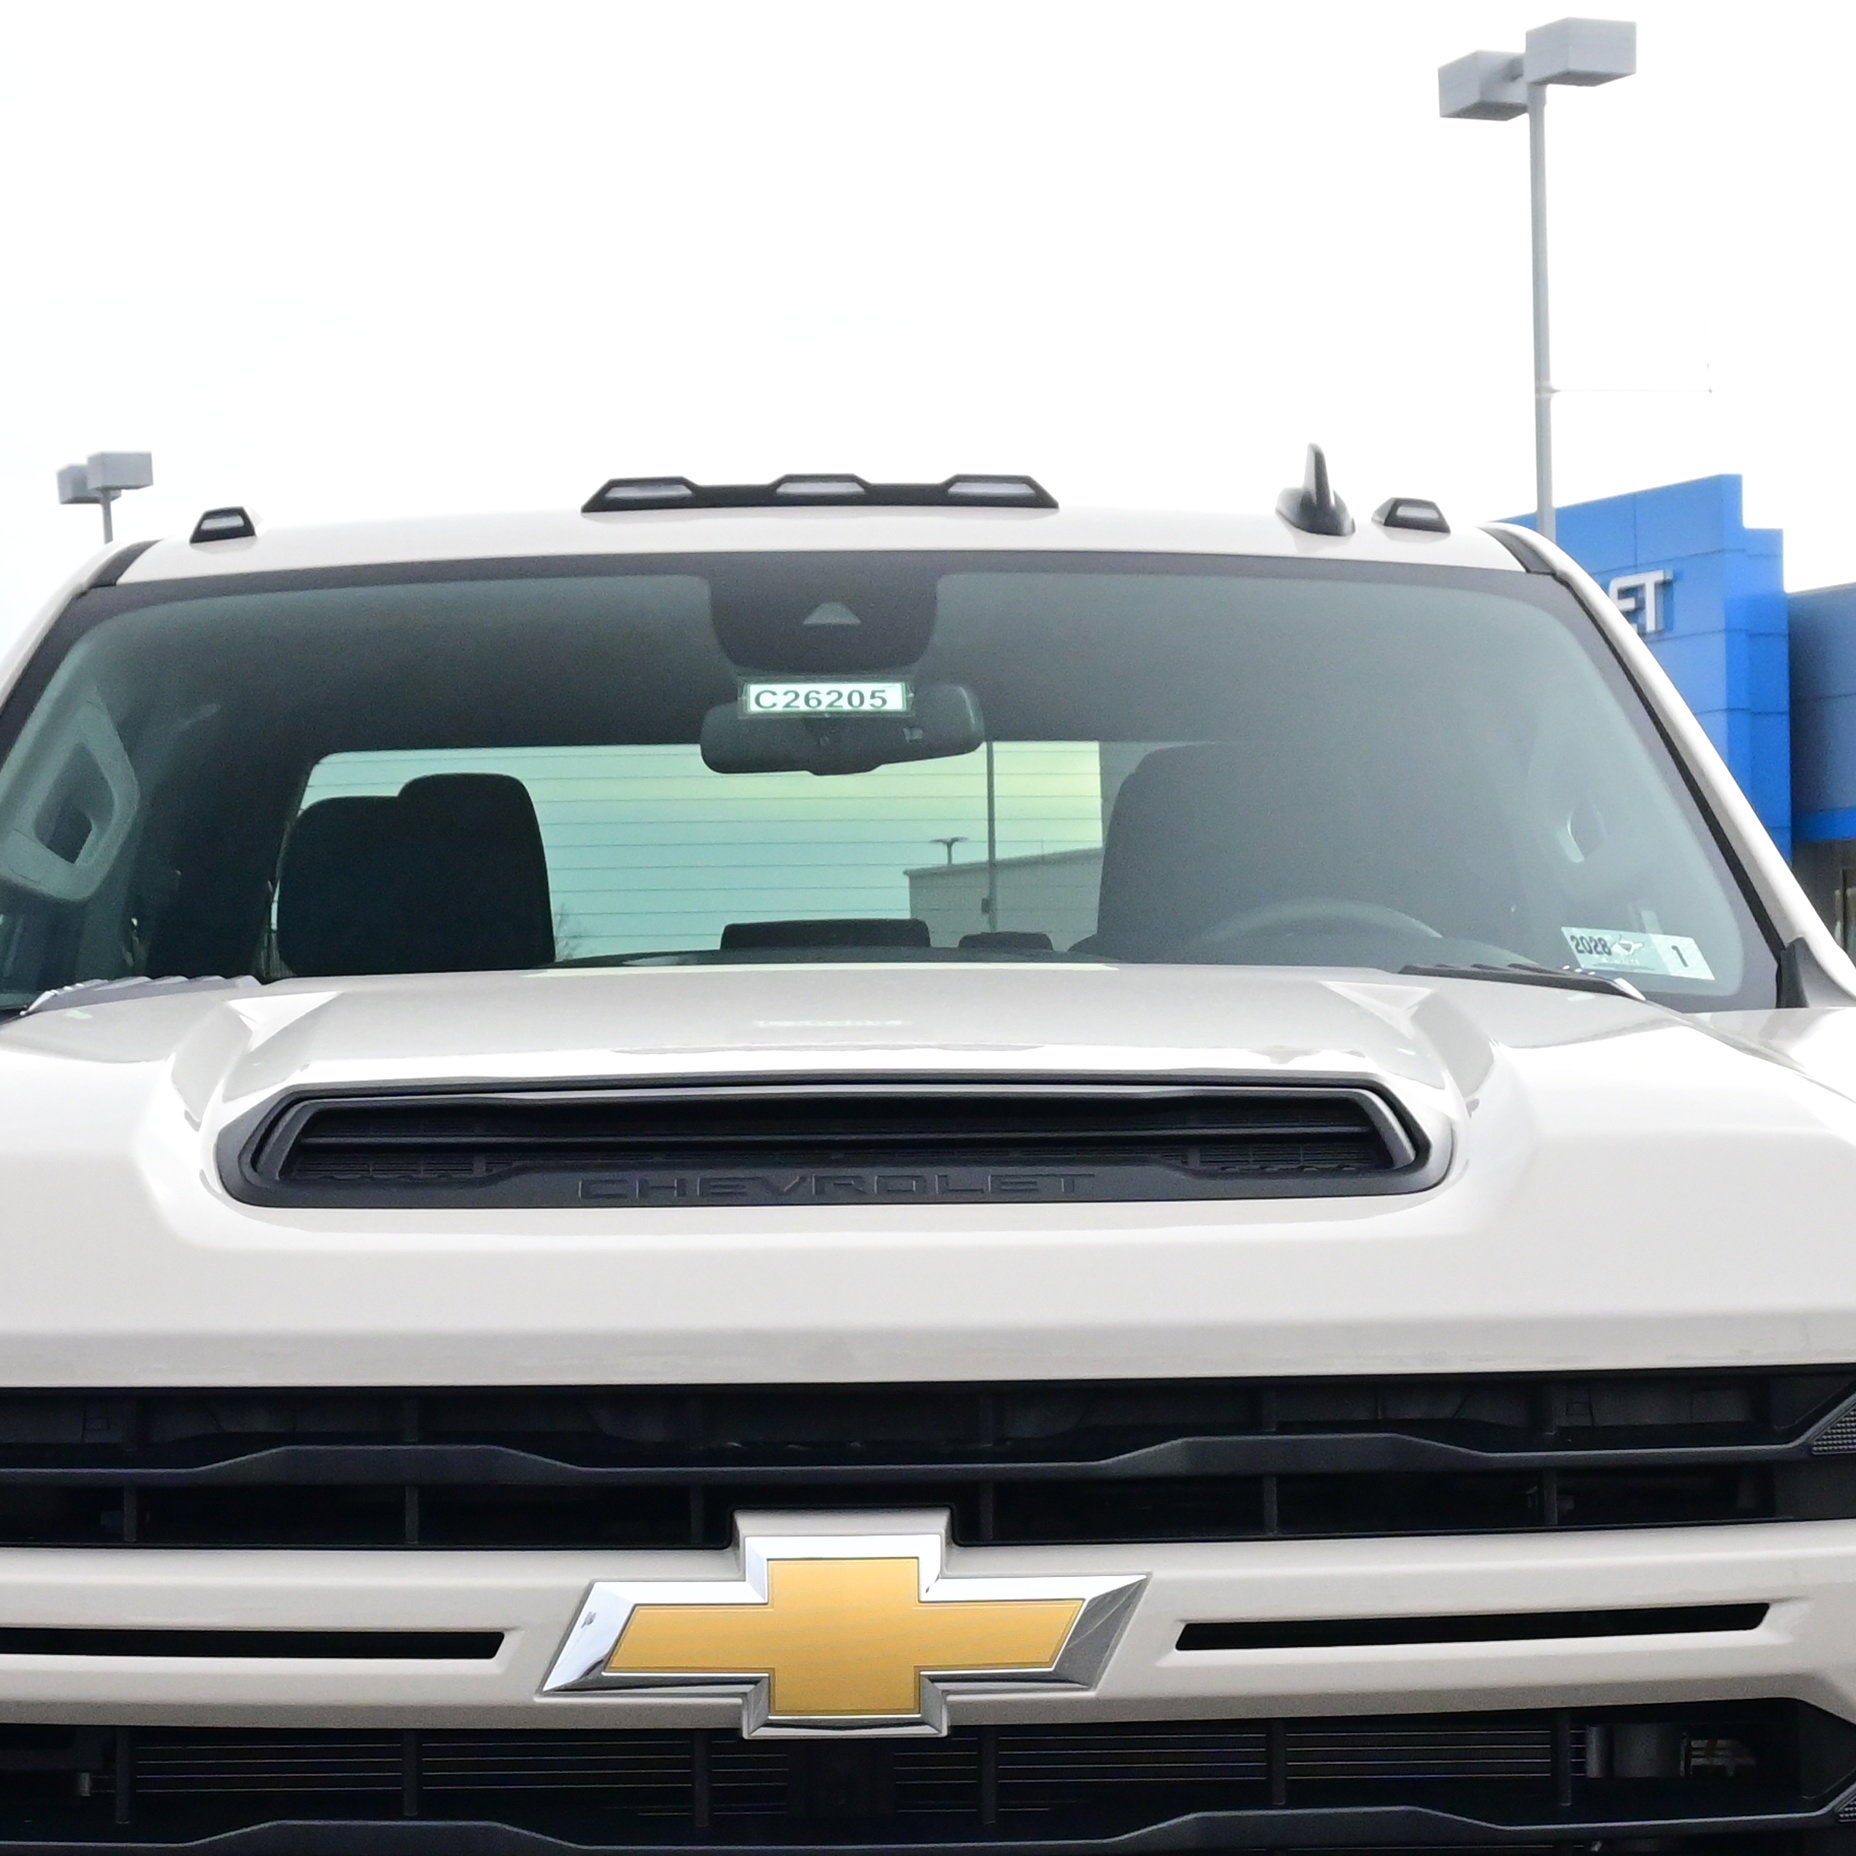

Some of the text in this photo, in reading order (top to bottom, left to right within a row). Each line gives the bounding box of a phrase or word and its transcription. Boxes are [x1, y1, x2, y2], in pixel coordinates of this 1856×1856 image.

[753, 689, 889, 710] C26205
[1569, 934, 1689, 968] 2028 1
[577, 1172, 1096, 1200] CHEVROLET
